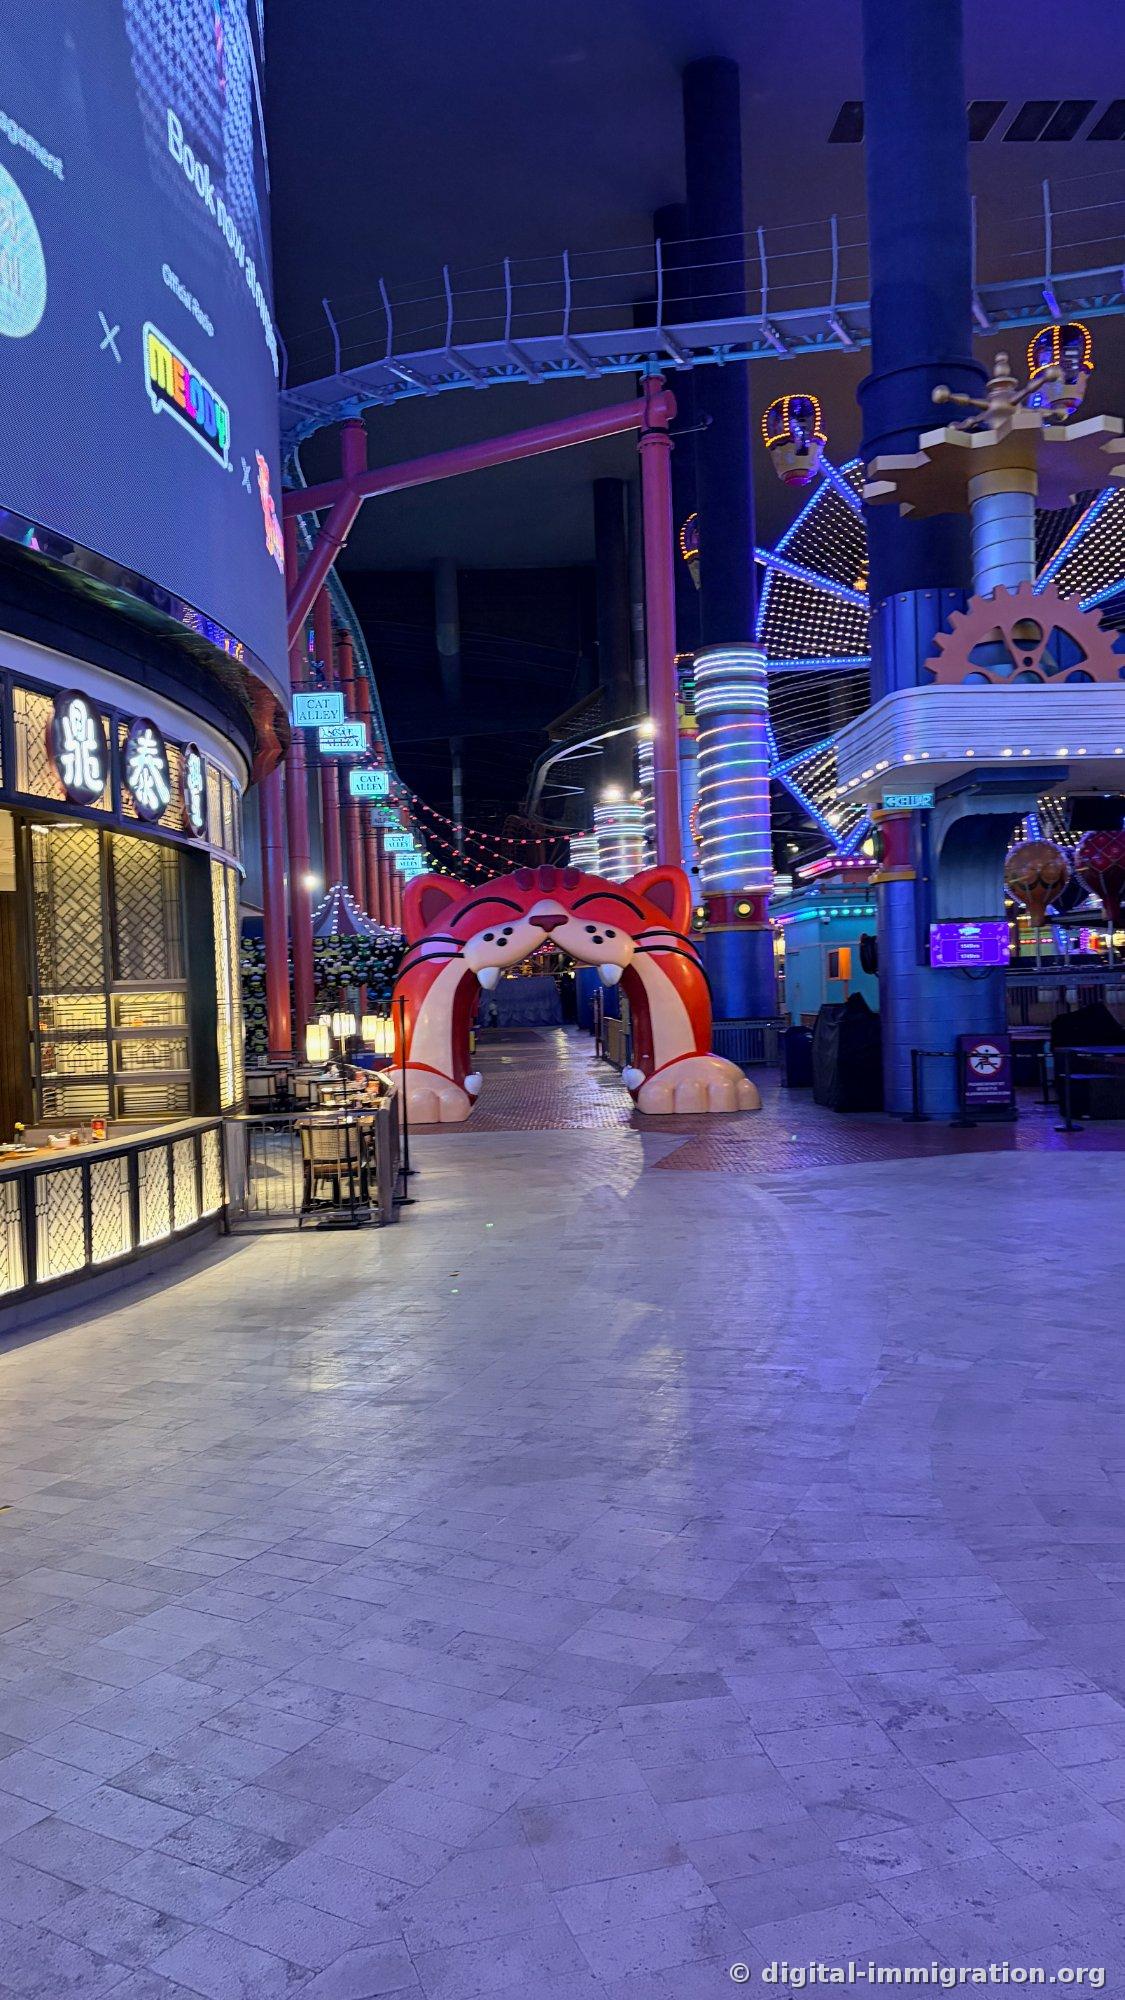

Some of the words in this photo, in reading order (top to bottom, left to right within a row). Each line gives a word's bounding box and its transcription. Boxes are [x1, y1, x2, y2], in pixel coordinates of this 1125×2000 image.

[167, 108, 216, 216] Book
[217, 197, 245, 268] now
[306, 699, 330, 709] CAT
[299, 710, 338, 721] ALLEY
[355, 783, 383, 791] ALLEY
